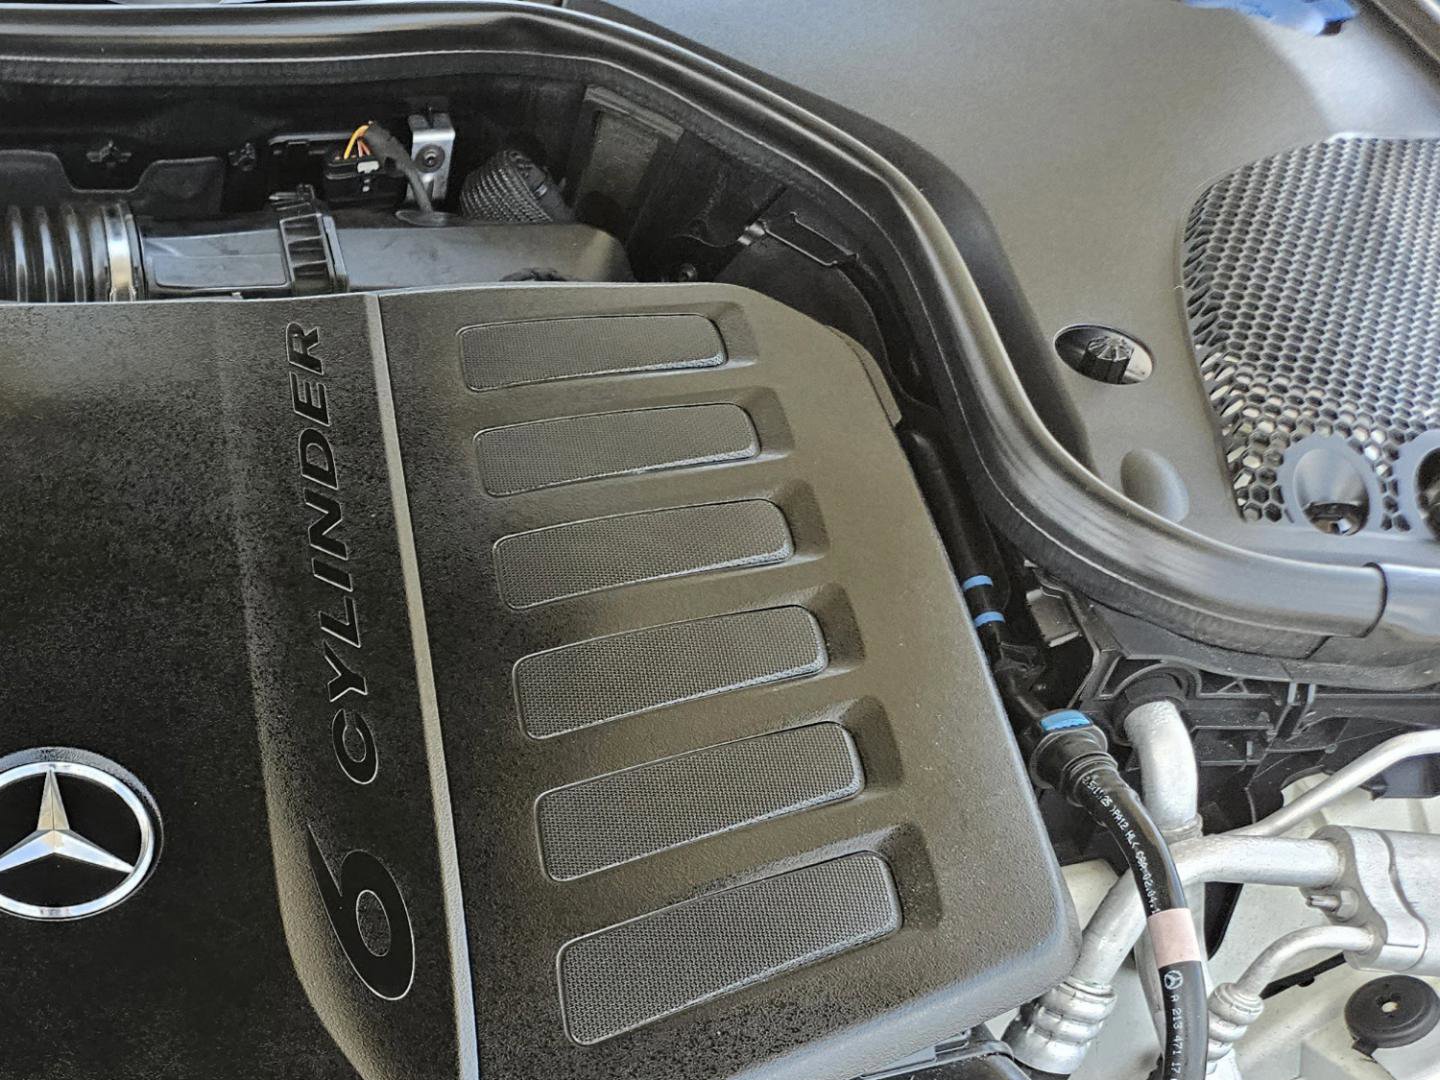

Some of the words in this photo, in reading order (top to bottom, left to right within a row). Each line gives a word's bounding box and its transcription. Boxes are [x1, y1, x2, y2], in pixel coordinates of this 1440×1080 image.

[286, 321, 378, 784] CYLINDER
[306, 823, 415, 1000] 6
[1171, 1007, 1183, 1030] 213
[1172, 1035, 1184, 1055] 471
[1170, 1061, 1182, 1074] 17
